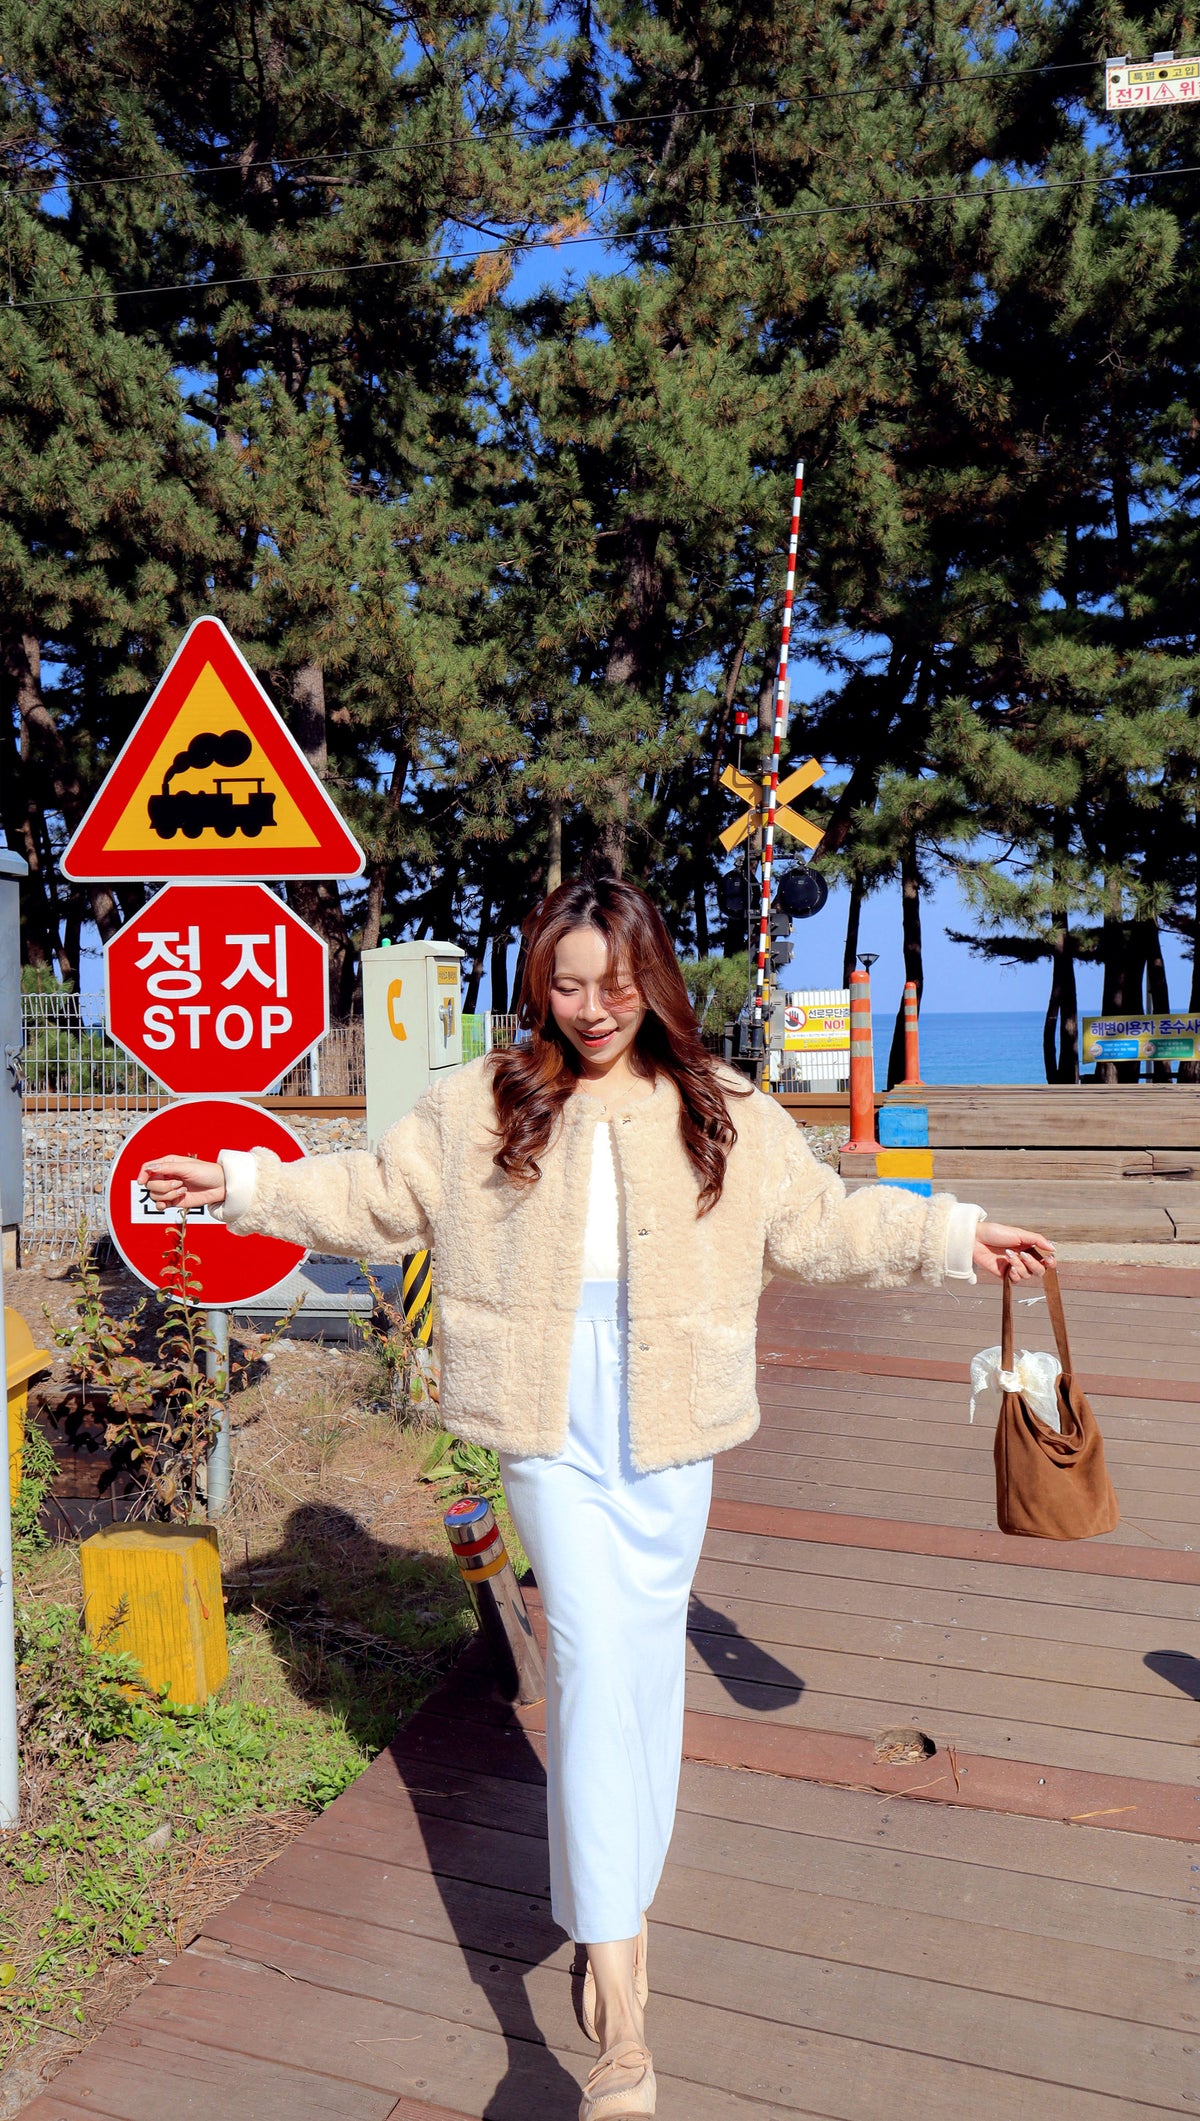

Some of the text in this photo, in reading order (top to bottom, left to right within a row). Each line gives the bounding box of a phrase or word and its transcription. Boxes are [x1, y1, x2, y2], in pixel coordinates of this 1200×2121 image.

[1172, 66, 1195, 77] 고압
[1116, 79, 1200, 104] 전기 위
[134, 925, 288, 1000] 정지
[142, 1004, 293, 1051] STOP
[824, 1019, 845, 1030] NO!
[1090, 1020, 1155, 1036] 해변이용자
